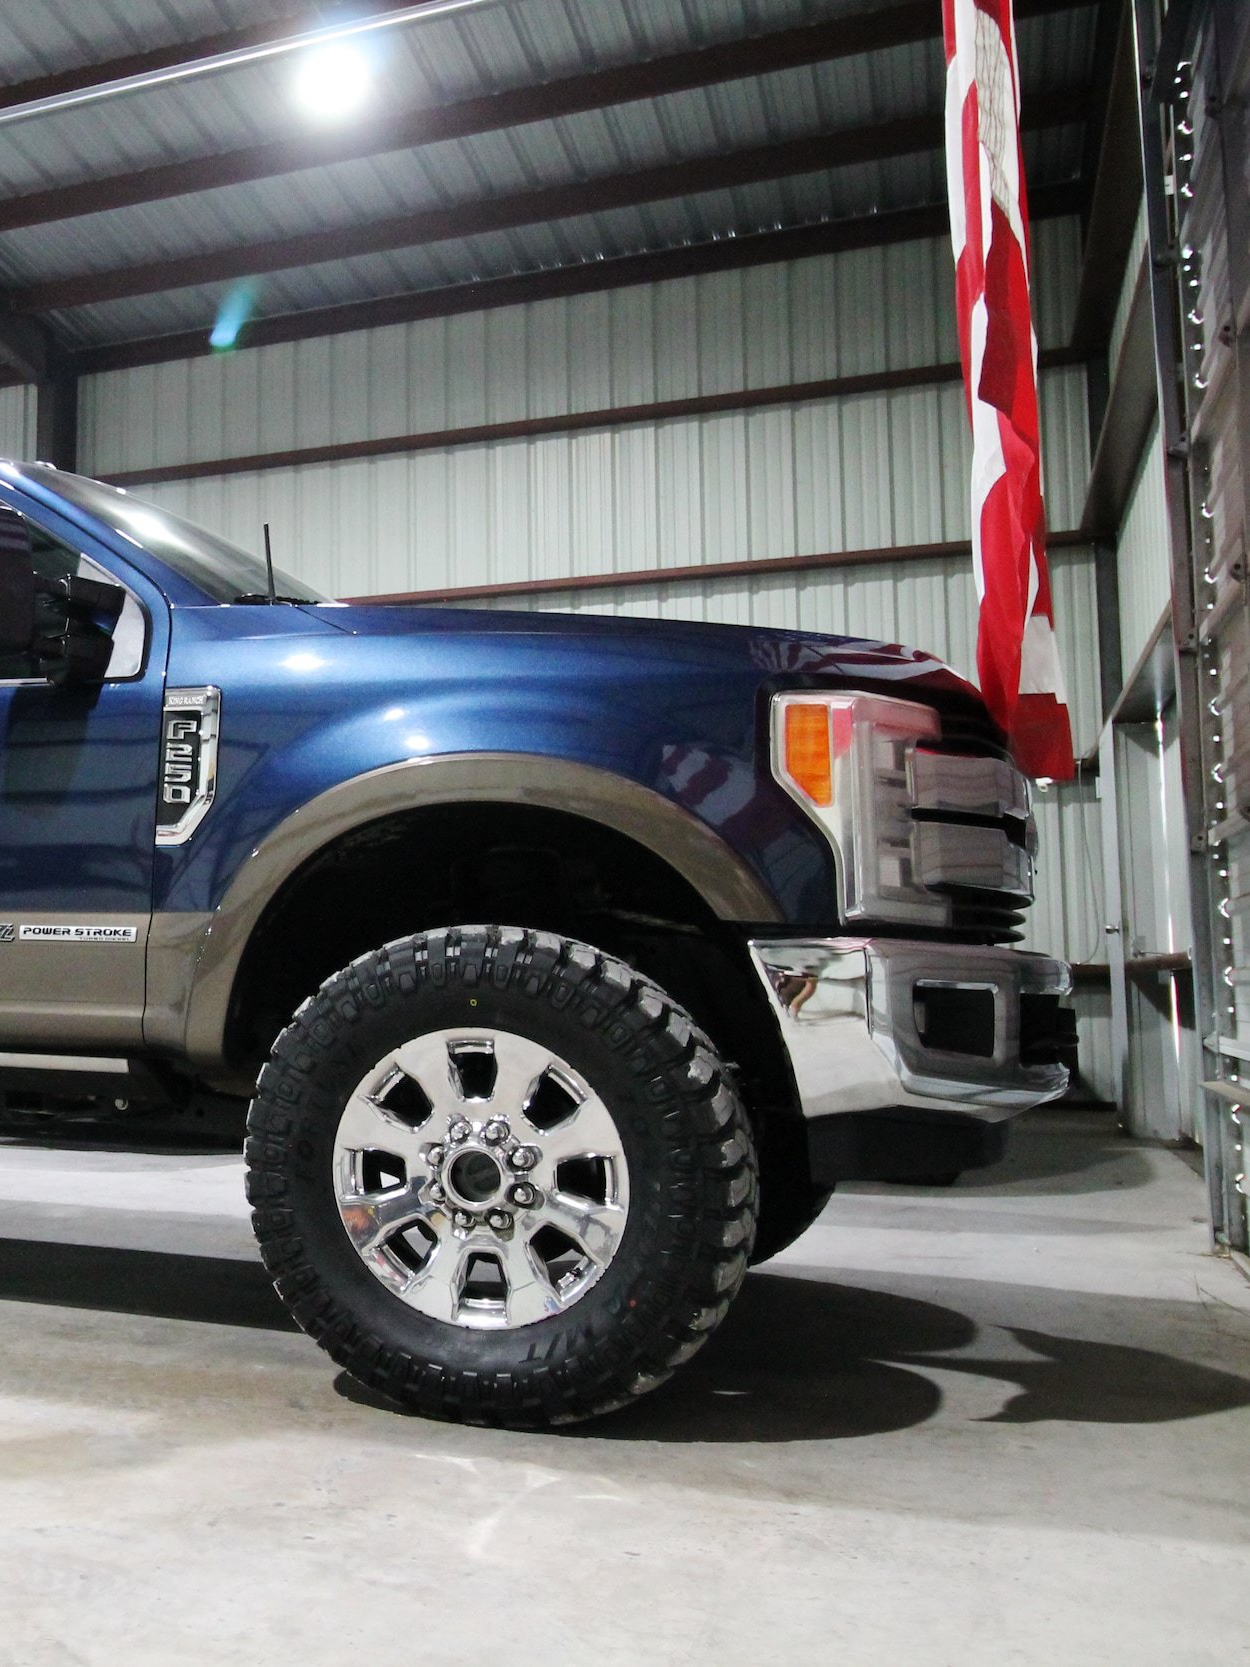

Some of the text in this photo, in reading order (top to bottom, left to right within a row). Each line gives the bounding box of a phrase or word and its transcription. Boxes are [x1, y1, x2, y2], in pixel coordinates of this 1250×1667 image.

[168, 695, 204, 705] KING RANCH
[163, 720, 197, 804] F250
[23, 927, 71, 936] POWER
[74, 928, 132, 937] STROKE
